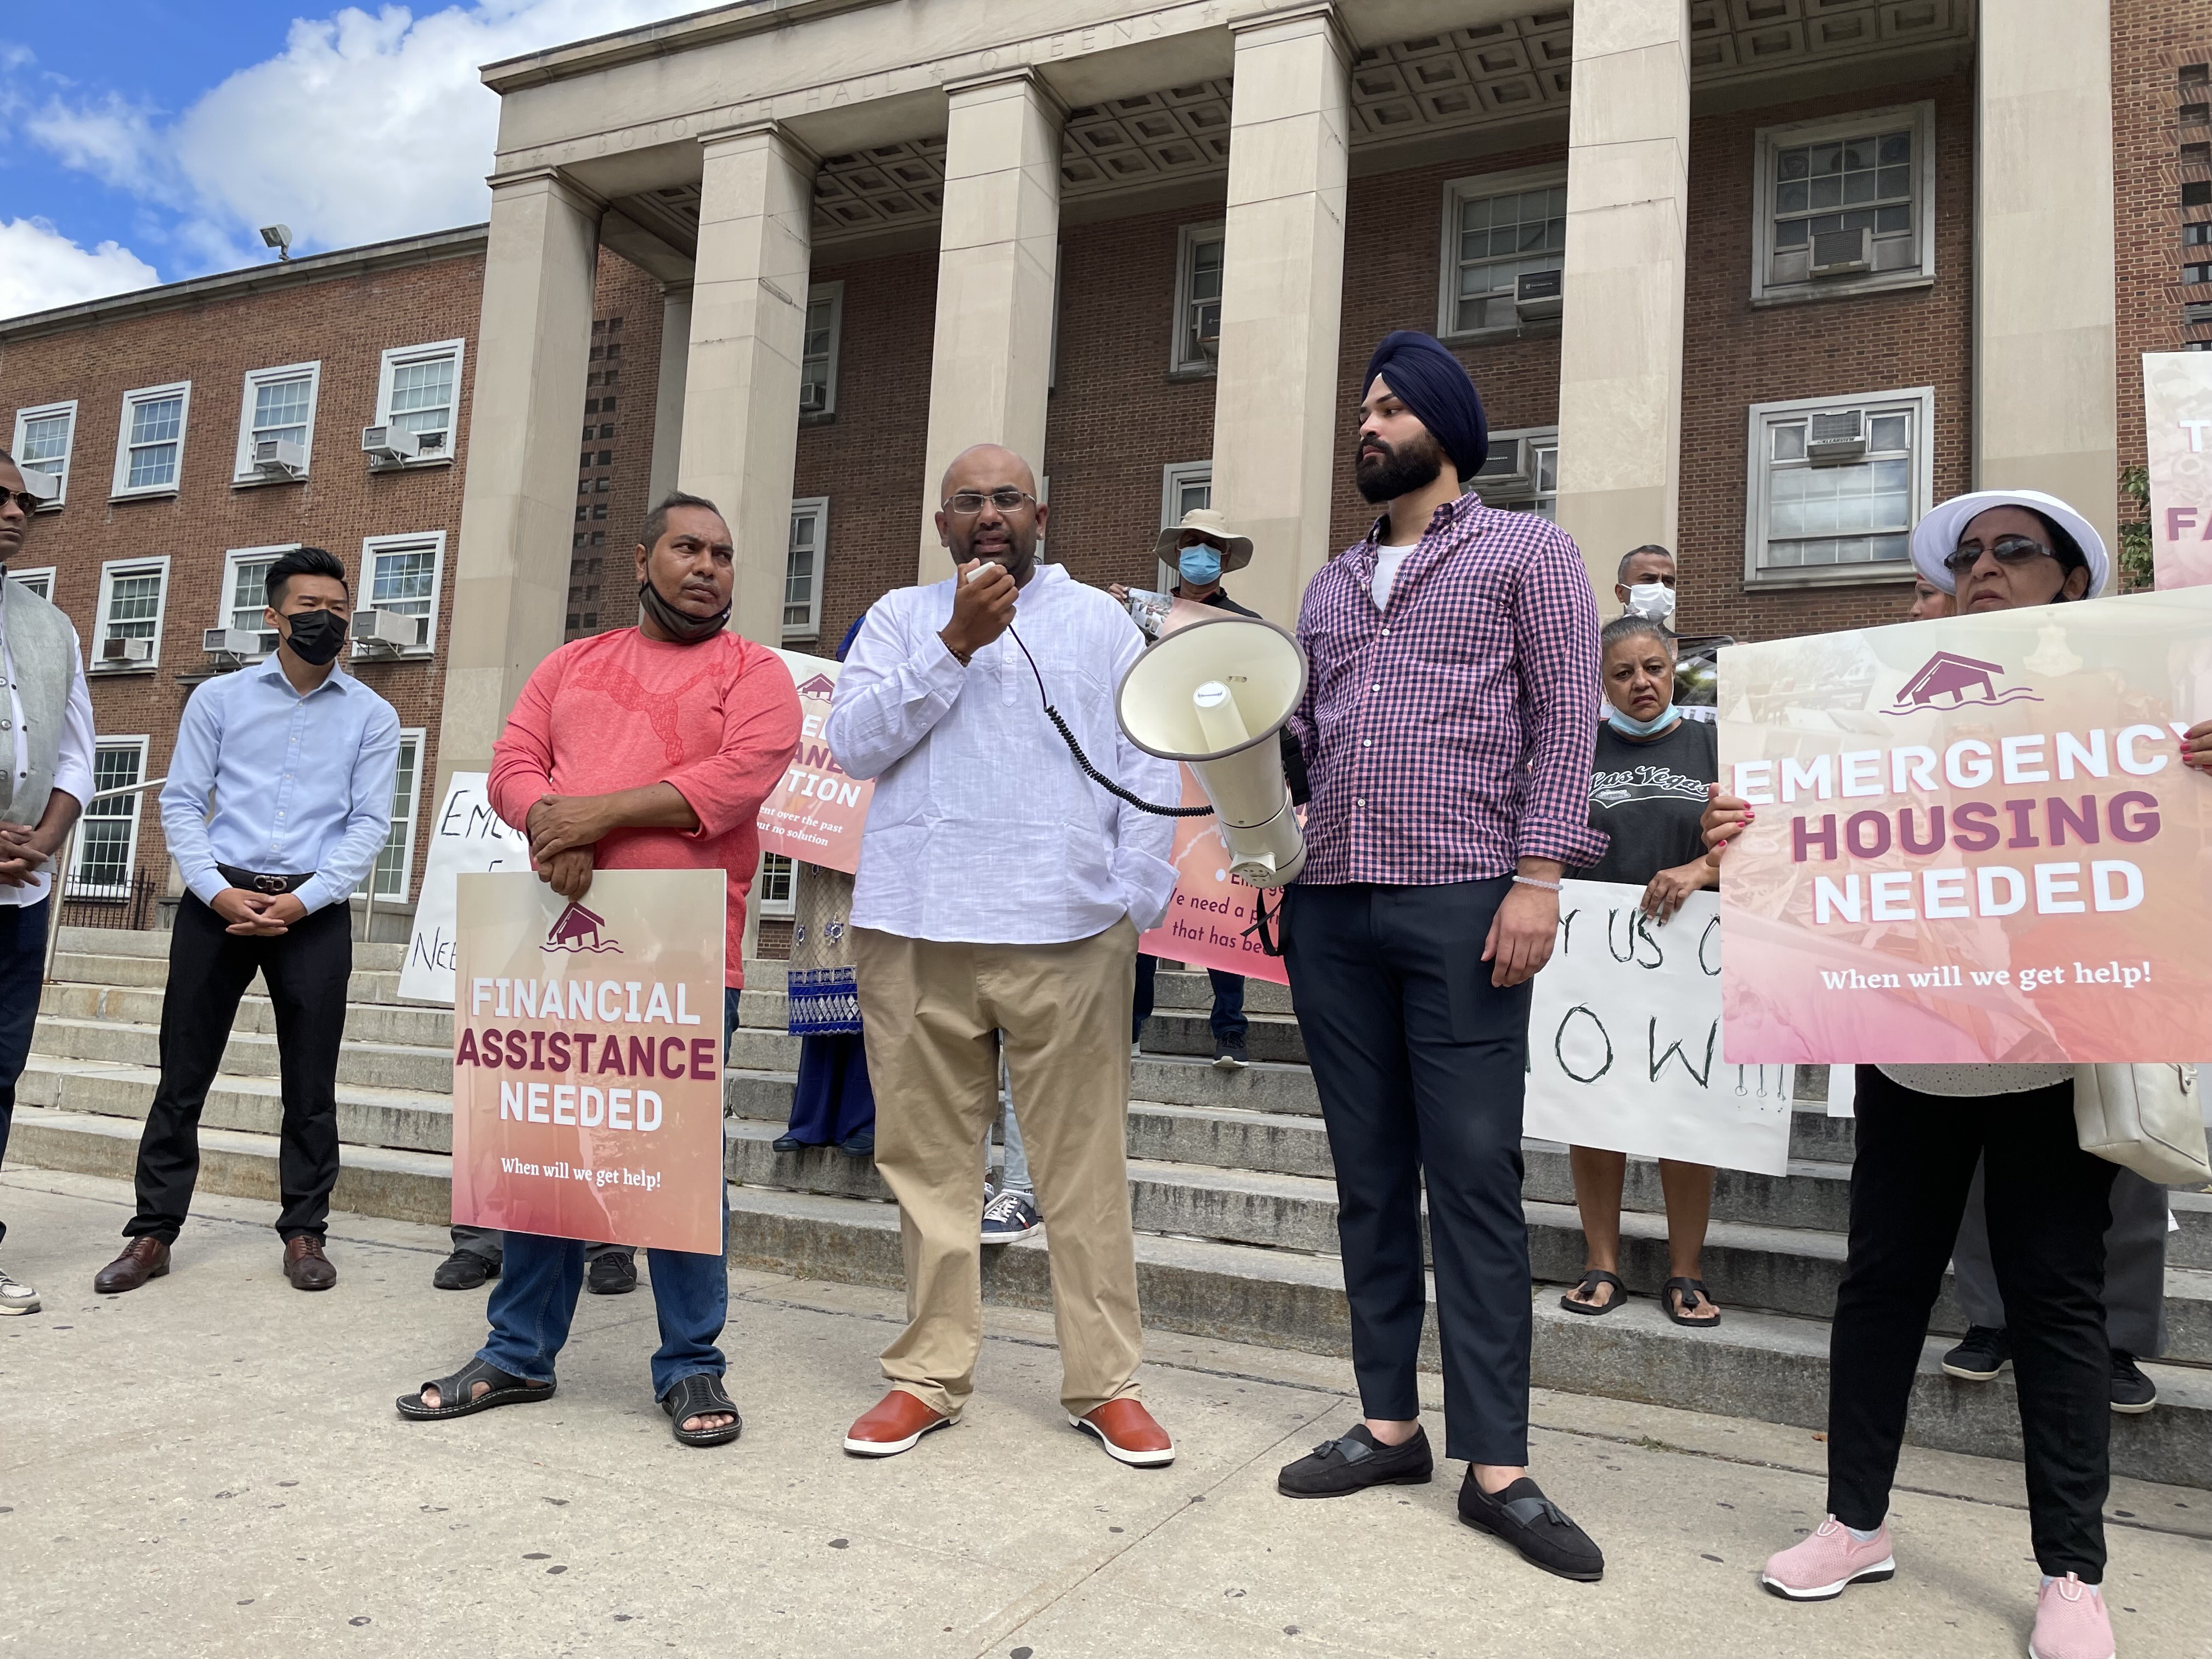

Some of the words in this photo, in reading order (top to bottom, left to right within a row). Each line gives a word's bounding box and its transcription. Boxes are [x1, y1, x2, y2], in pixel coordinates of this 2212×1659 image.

[597, 98, 773, 154] BOROUGH
[805, 72, 899, 110] HALL
[980, 12, 1164, 72] QUEENS
[777, 769, 862, 808] TION
[771, 826, 785, 834] no
[786, 829, 829, 847] solution
[777, 811, 800, 822] over
[802, 815, 819, 827] the
[820, 822, 843, 833] past
[1792, 791, 2162, 862] HOUSING
[1190, 896, 1231, 915] need
[1234, 906, 1244, 918] a
[1814, 860, 2146, 924] NEEDED
[1172, 918, 1204, 941] that
[1209, 925, 1237, 949] has
[1608, 907, 1663, 969] US
[1820, 968, 1901, 990] When
[1907, 965, 1962, 988] will
[1970, 968, 2011, 987] we
[2019, 965, 2065, 991] get
[2074, 961, 2152, 989] help!
[471, 978, 701, 1025] FINANCIAL
[456, 1028, 716, 1081] ASSISTANCE
[499, 1081, 663, 1132] NEEDED
[500, 1157, 540, 1176] When
[543, 1161, 569, 1179] will
[573, 1167, 592, 1181] we
[596, 1169, 619, 1187] get
[623, 1168, 661, 1191] help!
